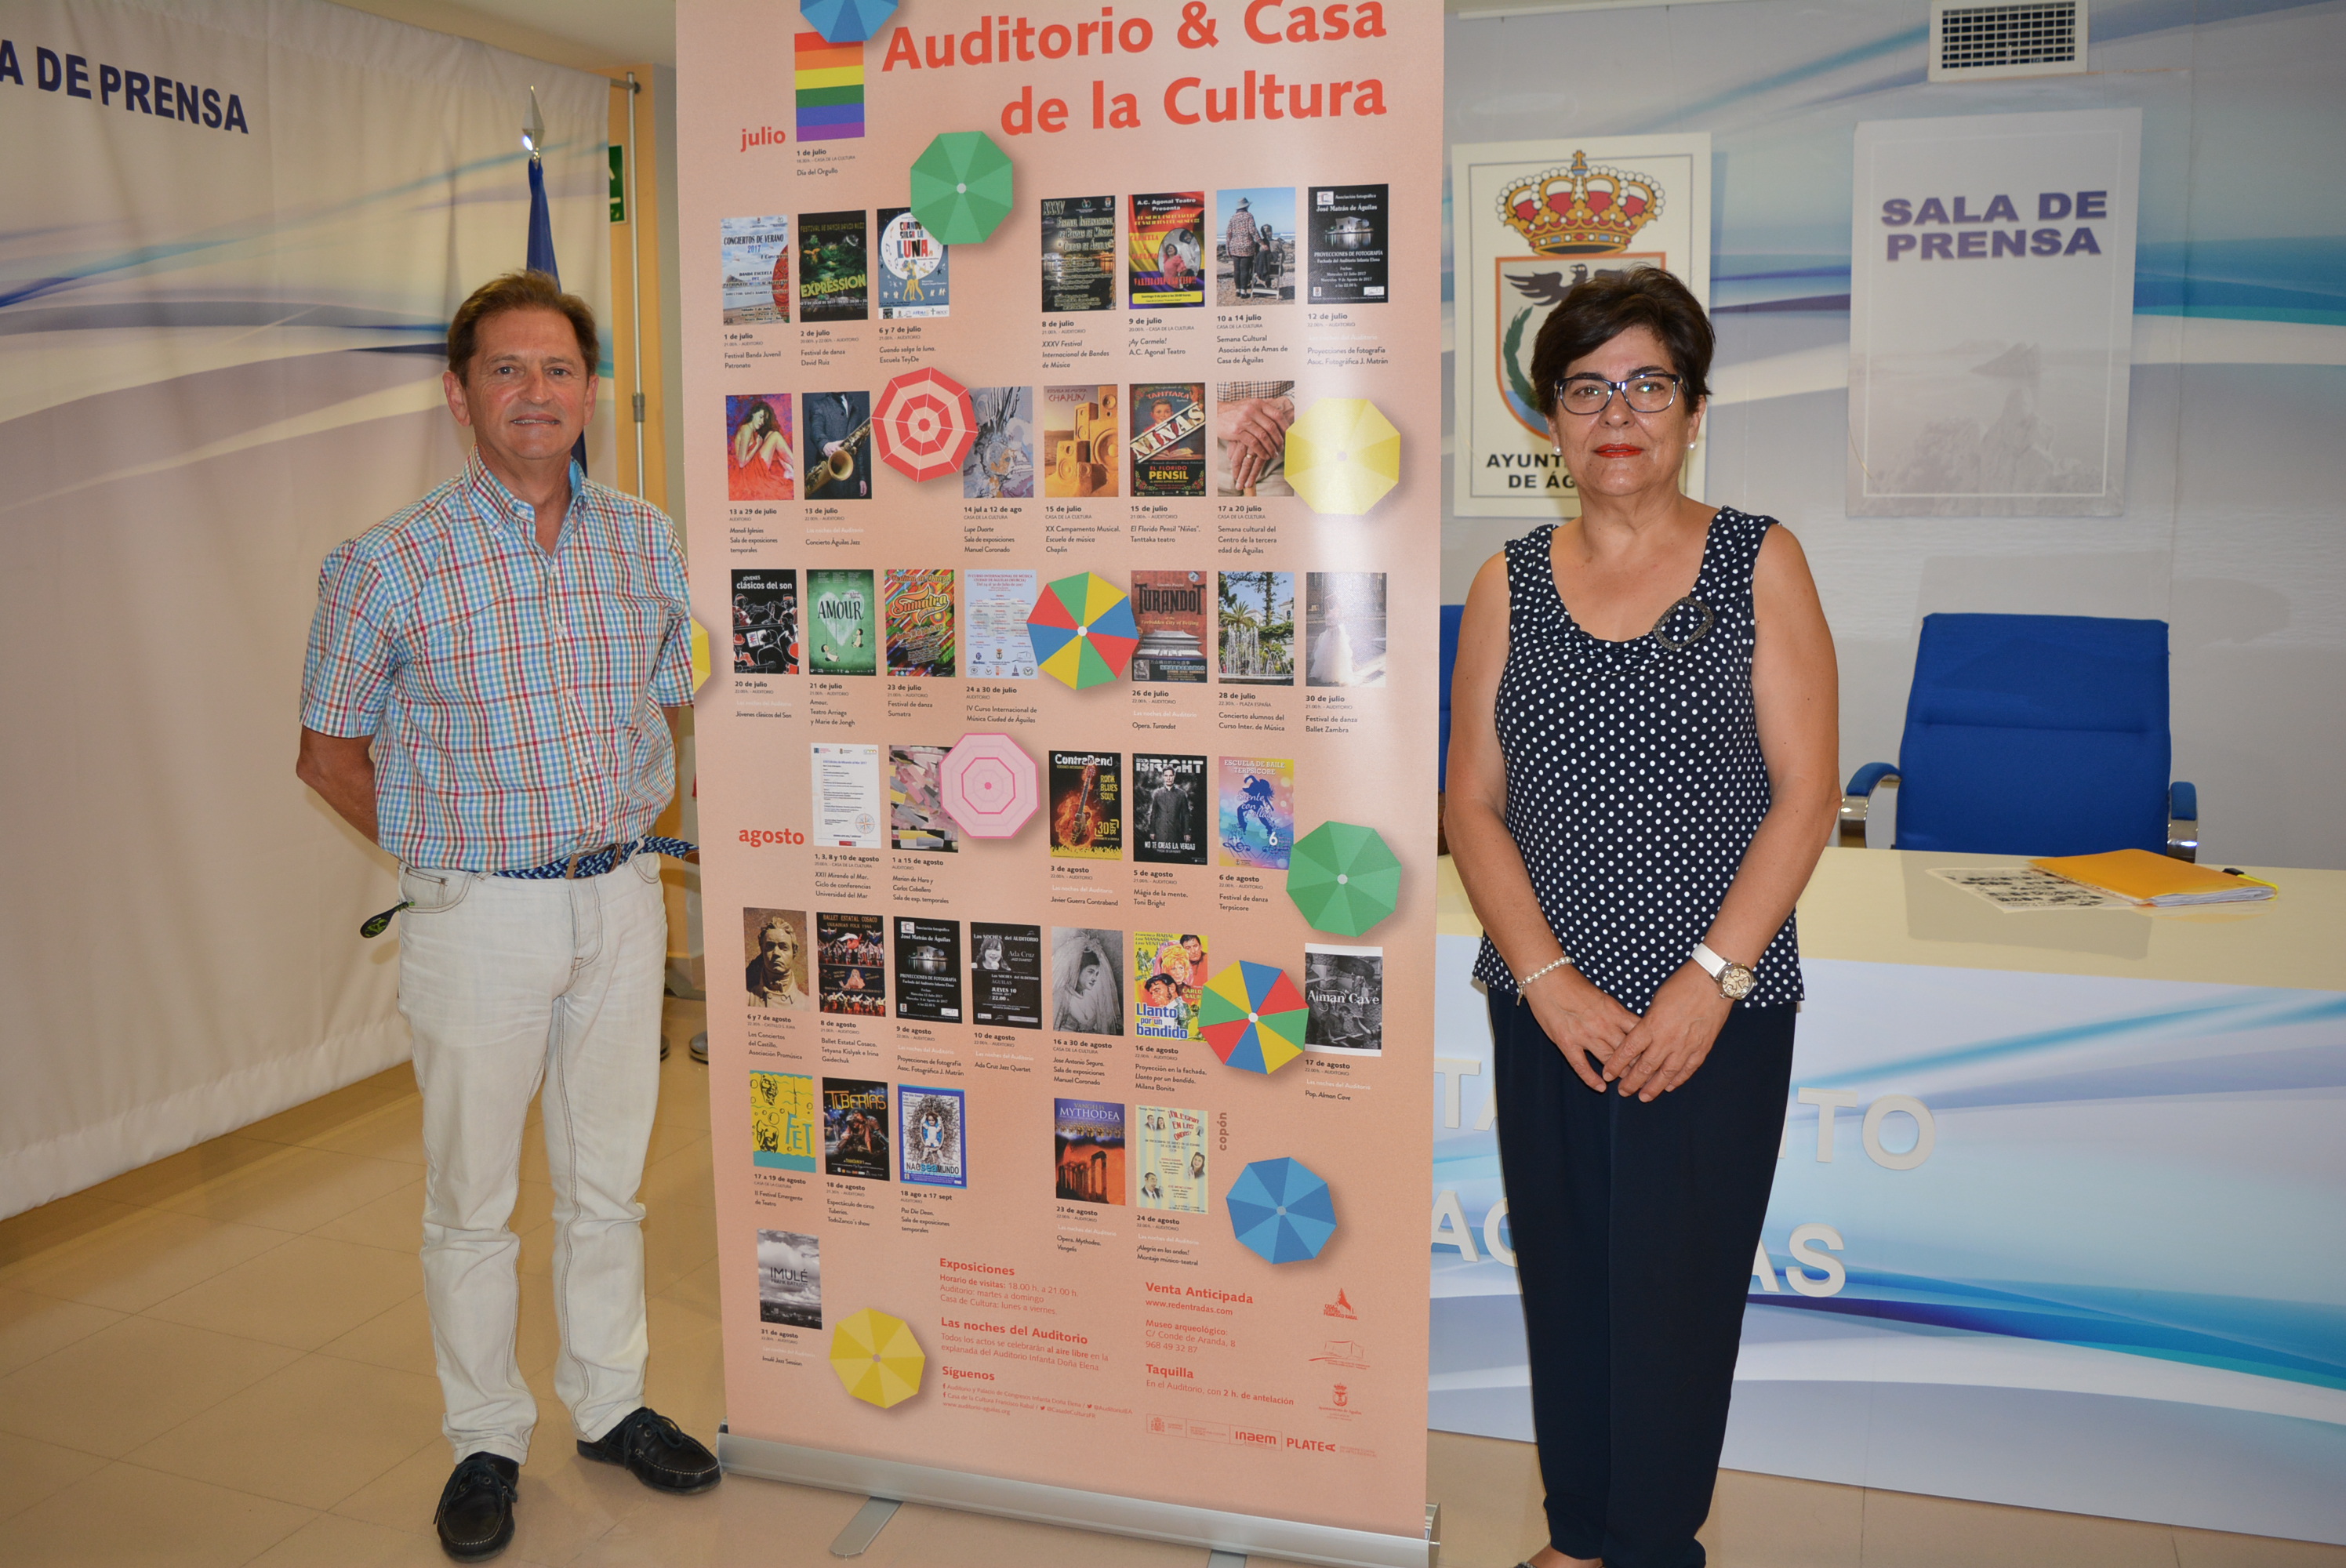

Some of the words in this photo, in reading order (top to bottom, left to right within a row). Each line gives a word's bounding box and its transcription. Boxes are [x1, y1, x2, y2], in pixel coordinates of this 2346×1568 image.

[881, 6, 1153, 72] Auditorio
[1176, 0, 1219, 49] &
[1244, 0, 1386, 45] Casa
[37, 45, 92, 100] DE
[100, 64, 249, 134] PRENSA
[1000, 85, 1068, 136] de
[1092, 81, 1140, 129] la
[1164, 71, 1386, 125] Cultura
[740, 126, 786, 152] julio
[1881, 194, 2019, 228] SALA
[2039, 190, 2106, 221] DE
[723, 236, 754, 245] CONCIERTOS
[764, 234, 784, 243] VERANO
[1887, 227, 2101, 261] PRENSA
[801, 274, 866, 297] EXPRESSION
[1245, 314, 1262, 323] julio
[1048, 394, 1086, 402] CHAPLIN
[1147, 390, 1190, 400] TANTTAKA
[1149, 470, 1189, 480] PENSIL
[1509, 475, 1536, 488] DE
[736, 580, 764, 590] clásicos
[766, 581, 777, 590] del
[1135, 583, 1206, 615] TURANDOT
[817, 601, 864, 620] AMOUR
[1100, 775, 1115, 783] ROCK
[1100, 783, 1118, 792] BLUES
[1100, 792, 1115, 800] SOUL
[739, 829, 804, 848] agosto
[1136, 1003, 1176, 1018] Llanto
[1141, 1018, 1152, 1026] por
[1136, 1025, 1188, 1040] bandido
[1060, 1108, 1120, 1120] MYTHODEA
[940, 1258, 1015, 1276] Exposiciones
[940, 1274, 966, 1285] Horario
[979, 1279, 1006, 1288] visitas:
[1008, 1282, 1030, 1290] 18.00
[977, 1290, 1001, 1298] martes
[1011, 1293, 1044, 1303] domingo
[1146, 1282, 1181, 1295] Venta
[1186, 1287, 1253, 1303] Anticipada
[940, 1294, 957, 1303] Casa
[971, 1298, 999, 1308] Cultura:
[1001, 1301, 1021, 1310] lunes
[1146, 1300, 1233, 1315] www.redentradas.com
[941, 1317, 960, 1328] Las
[964, 1321, 1005, 1333] noches
[1010, 1325, 1027, 1335] del
[1032, 1328, 1088, 1344] Auditorio
[1146, 1319, 1172, 1329] Museo
[1175, 1322, 1227, 1335] arqueológico:
[1146, 1330, 1156, 1338] C/
[1158, 1331, 1183, 1341] Conde
[1186, 1334, 1195, 1342] de
[1198, 1336, 1228, 1347] Aranda,
[942, 1334, 962, 1342] Todos
[964, 1335, 974, 1344] los
[976, 1338, 996, 1346] actos
[1008, 1341, 1044, 1352] celebrarán
[1055, 1347, 1070, 1356] aire
[1072, 1348, 1088, 1358] libre
[1102, 1352, 1109, 1361] la
[942, 1345, 978, 1356] explanada
[993, 1349, 1027, 1359] Auditorio
[1030, 1354, 1055, 1364] Infanta
[1058, 1357, 1077, 1367] Doña
[1079, 1361, 1099, 1370] Elena
[942, 1366, 995, 1381] Síguenos
[1146, 1364, 1193, 1378] Taquilla
[1167, 1382, 1204, 1394] Auditorio,
[1231, 1389, 1239, 1398] h.
[1253, 1393, 1294, 1405] antelación
